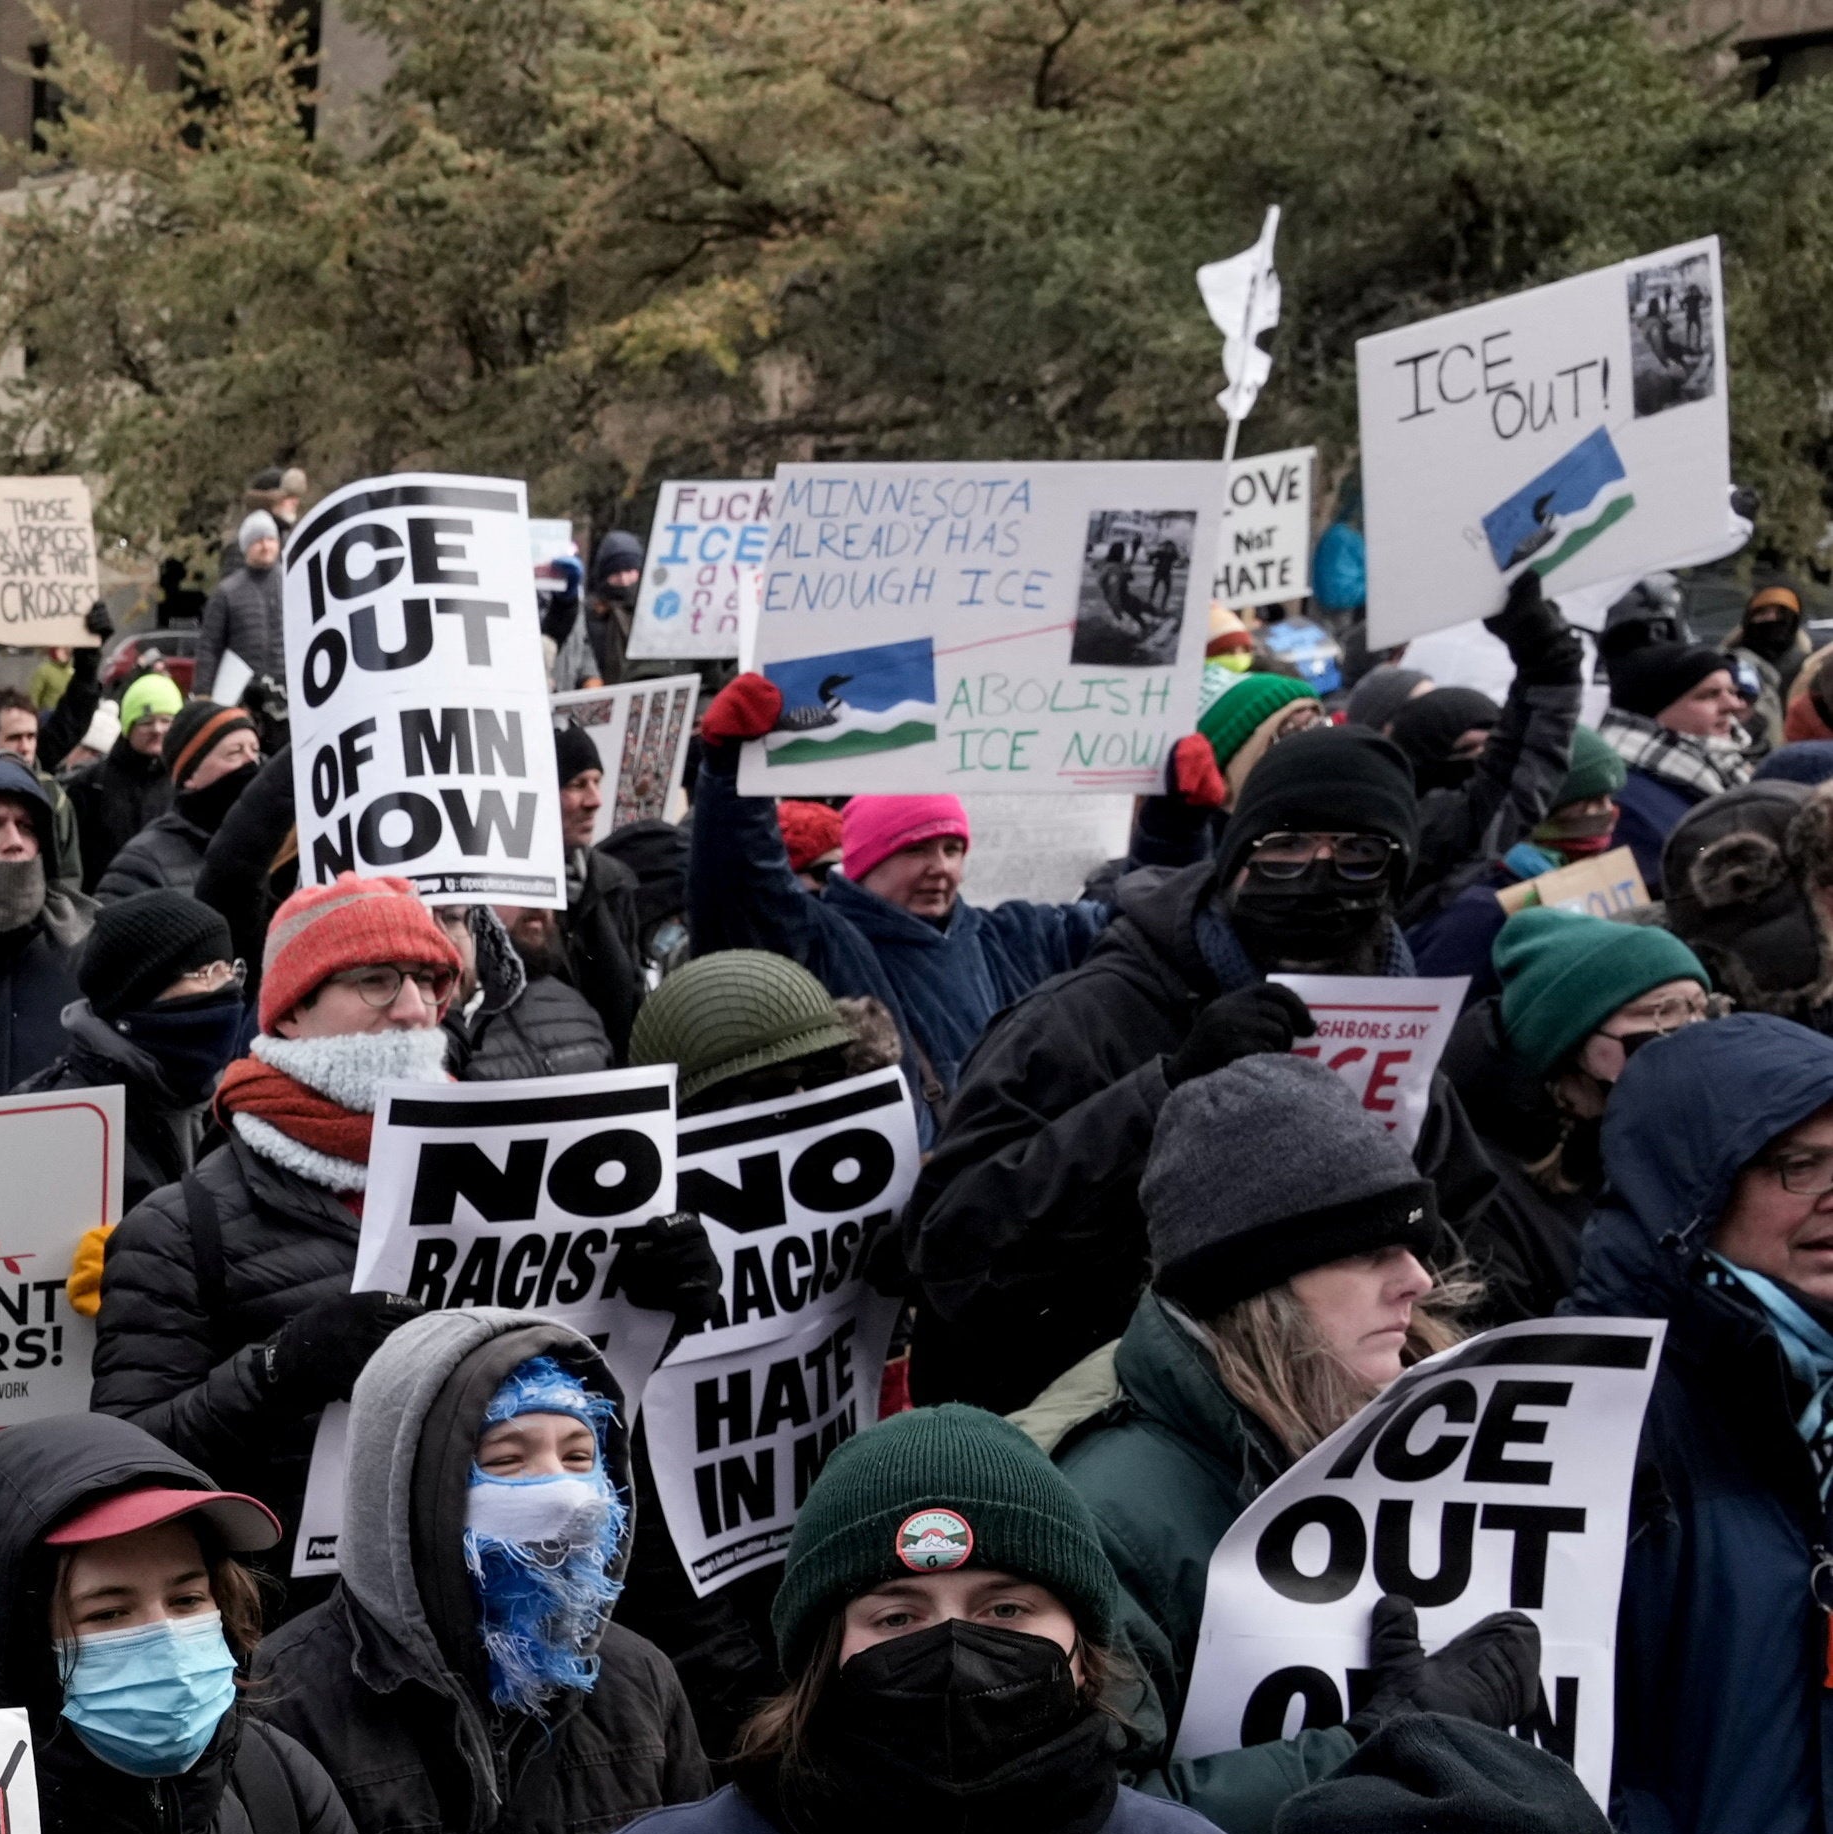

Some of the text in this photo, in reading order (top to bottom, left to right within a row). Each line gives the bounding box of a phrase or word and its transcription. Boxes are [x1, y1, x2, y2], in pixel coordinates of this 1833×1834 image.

[1394, 330, 1515, 423] ICE
[1491, 355, 1612, 440] OUT!
[1, 497, 73, 522] THOSE
[776, 478, 1031, 519] MINNESOTA
[1223, 465, 1300, 516] OVE
[0, 551, 48, 575] SAME
[50, 553, 90, 576] THAT
[305, 517, 479, 625] ICE
[658, 524, 769, 564] ICE
[769, 519, 1021, 560] ALREADY HAS
[1, 582, 94, 624] CROSSES
[764, 565, 936, 613] ENOUGH
[958, 569, 1052, 609] ICE
[302, 597, 510, 710] OUT
[945, 675, 1171, 719] ABOLISH
[310, 706, 526, 819] OF MN
[948, 731, 1164, 772] ICE NOW
[311, 789, 538, 889] NOW
[1315, 1020, 1429, 1040] GHBORS SAY
[410, 1128, 662, 1225] NO
[676, 1128, 894, 1234] NO
[699, 1212, 894, 1337] ACIST
[694, 1318, 855, 1452] HATE
[1325, 1380, 1573, 1486] ICE
[694, 1447, 778, 1540] IN
[1255, 1495, 1586, 1609] OUT
[1240, 1665, 1375, 1749] O
